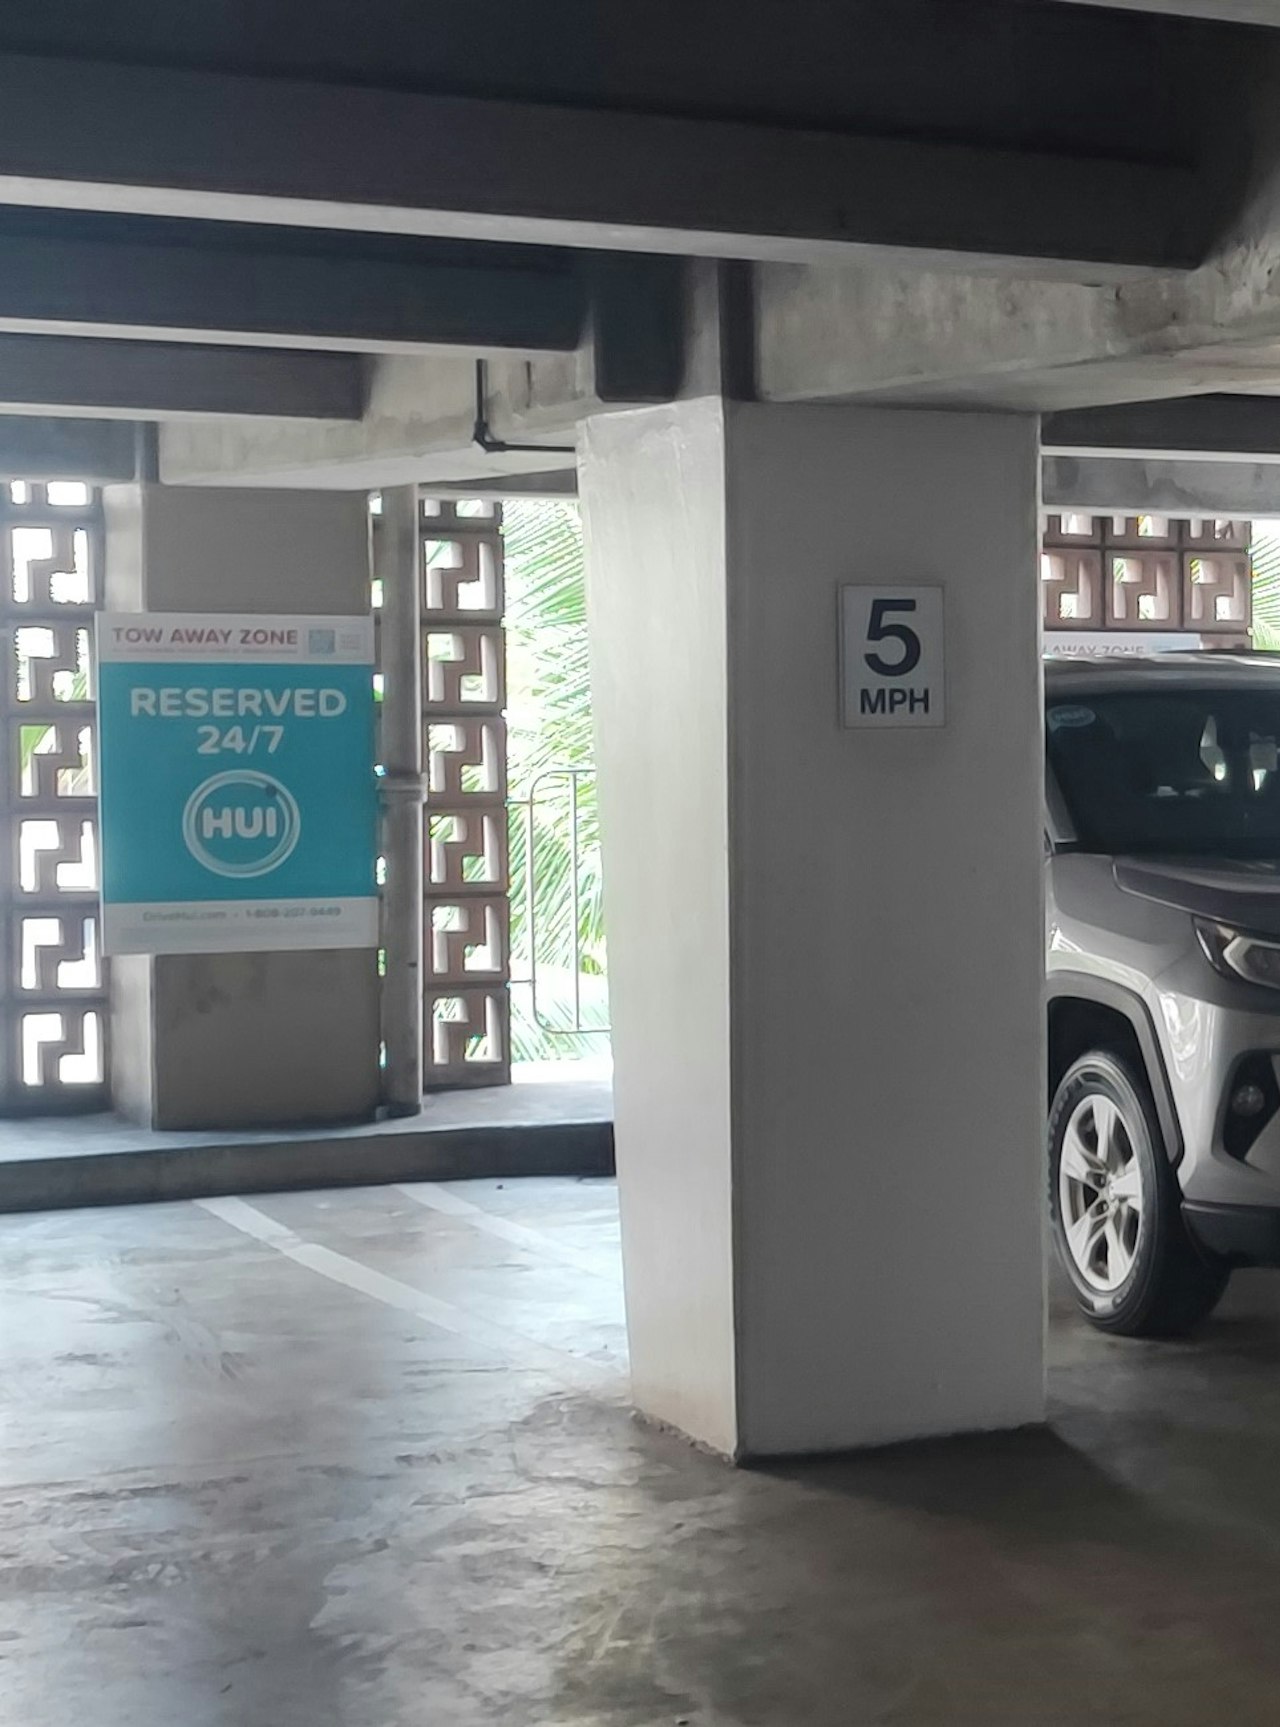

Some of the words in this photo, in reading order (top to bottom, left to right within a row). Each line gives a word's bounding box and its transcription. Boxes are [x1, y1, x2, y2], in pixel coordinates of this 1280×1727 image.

[113, 628, 163, 643] TOW
[170, 628, 232, 645] AWAY
[239, 629, 298, 645] ZONE
[864, 598, 921, 677] 5
[130, 687, 348, 717] RESERVED
[860, 688, 930, 714] MPH
[197, 725, 284, 754] 24/7
[202, 806, 277, 839] HUI
